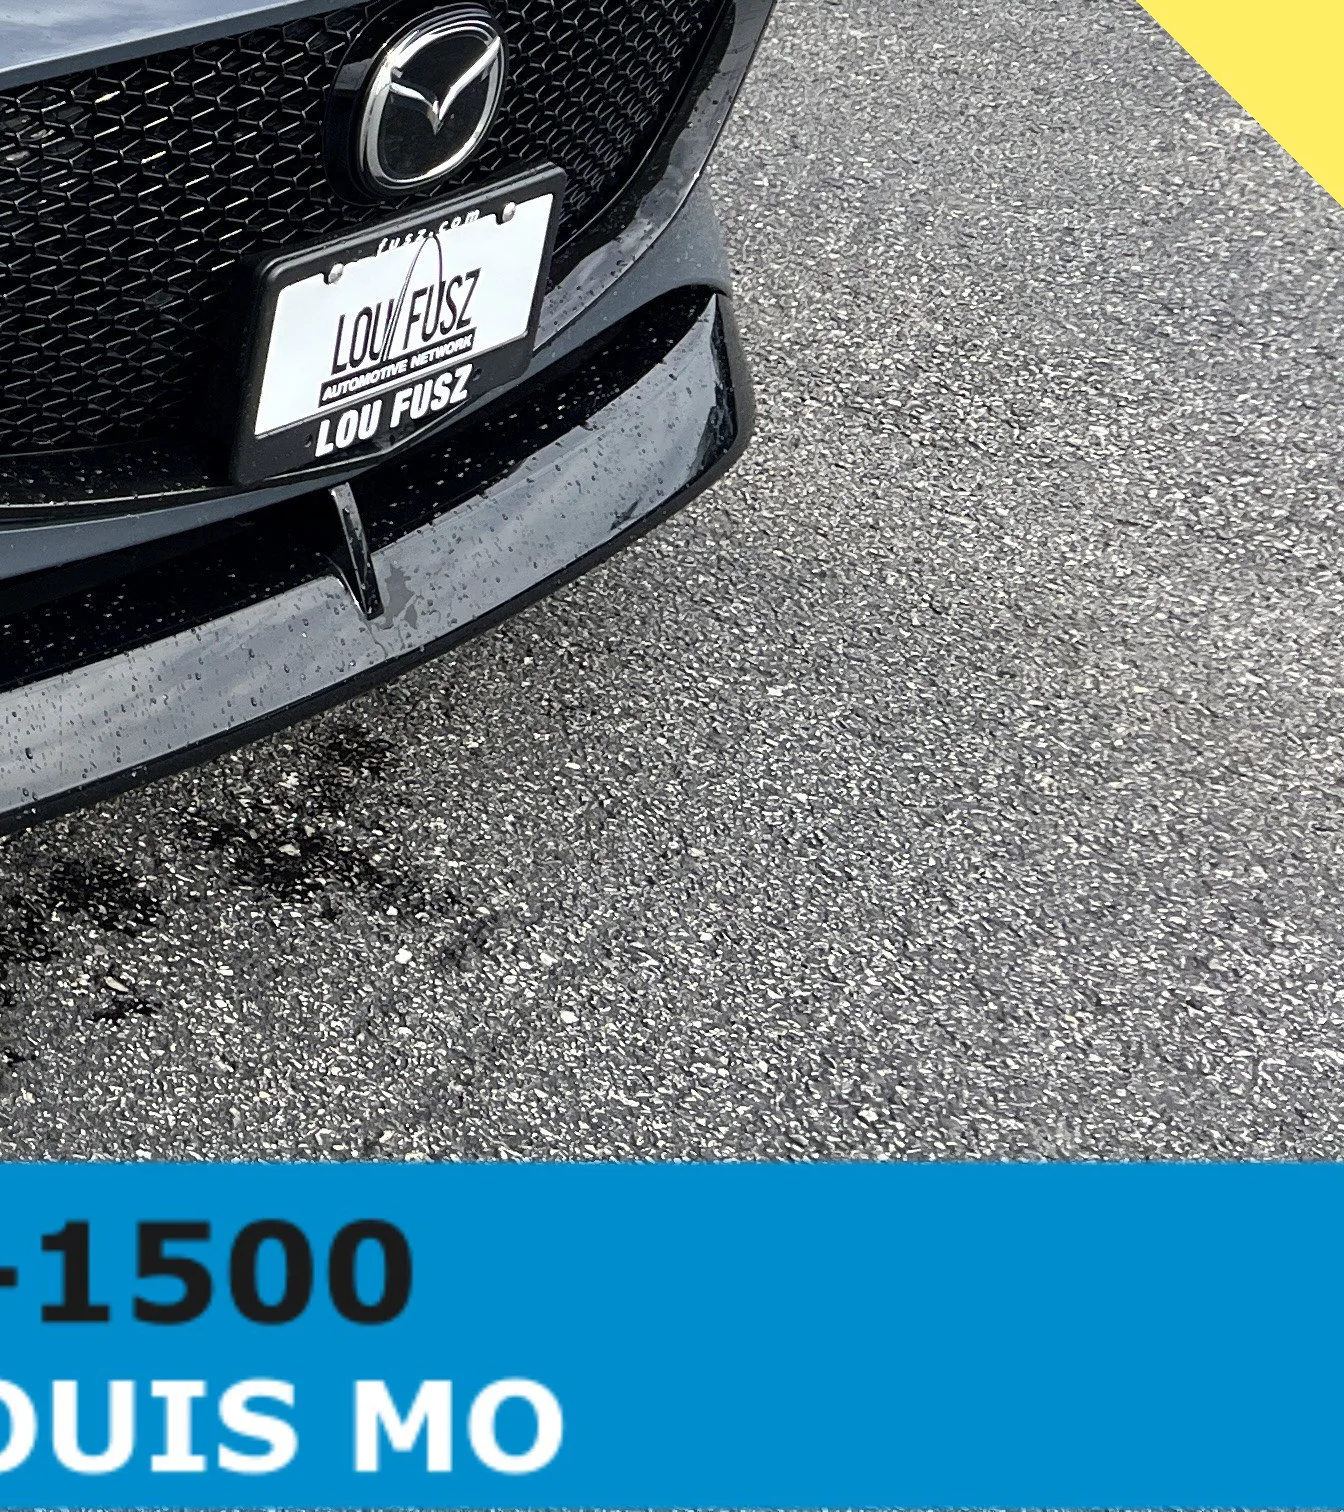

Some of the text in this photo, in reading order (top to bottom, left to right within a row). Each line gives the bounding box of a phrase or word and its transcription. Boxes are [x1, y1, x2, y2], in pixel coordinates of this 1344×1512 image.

[321, 333, 475, 402] AUTOMOTIVE NETWORK
[330, 267, 483, 376] LOU FUSZ
[314, 363, 474, 458] LOU FUSZ
